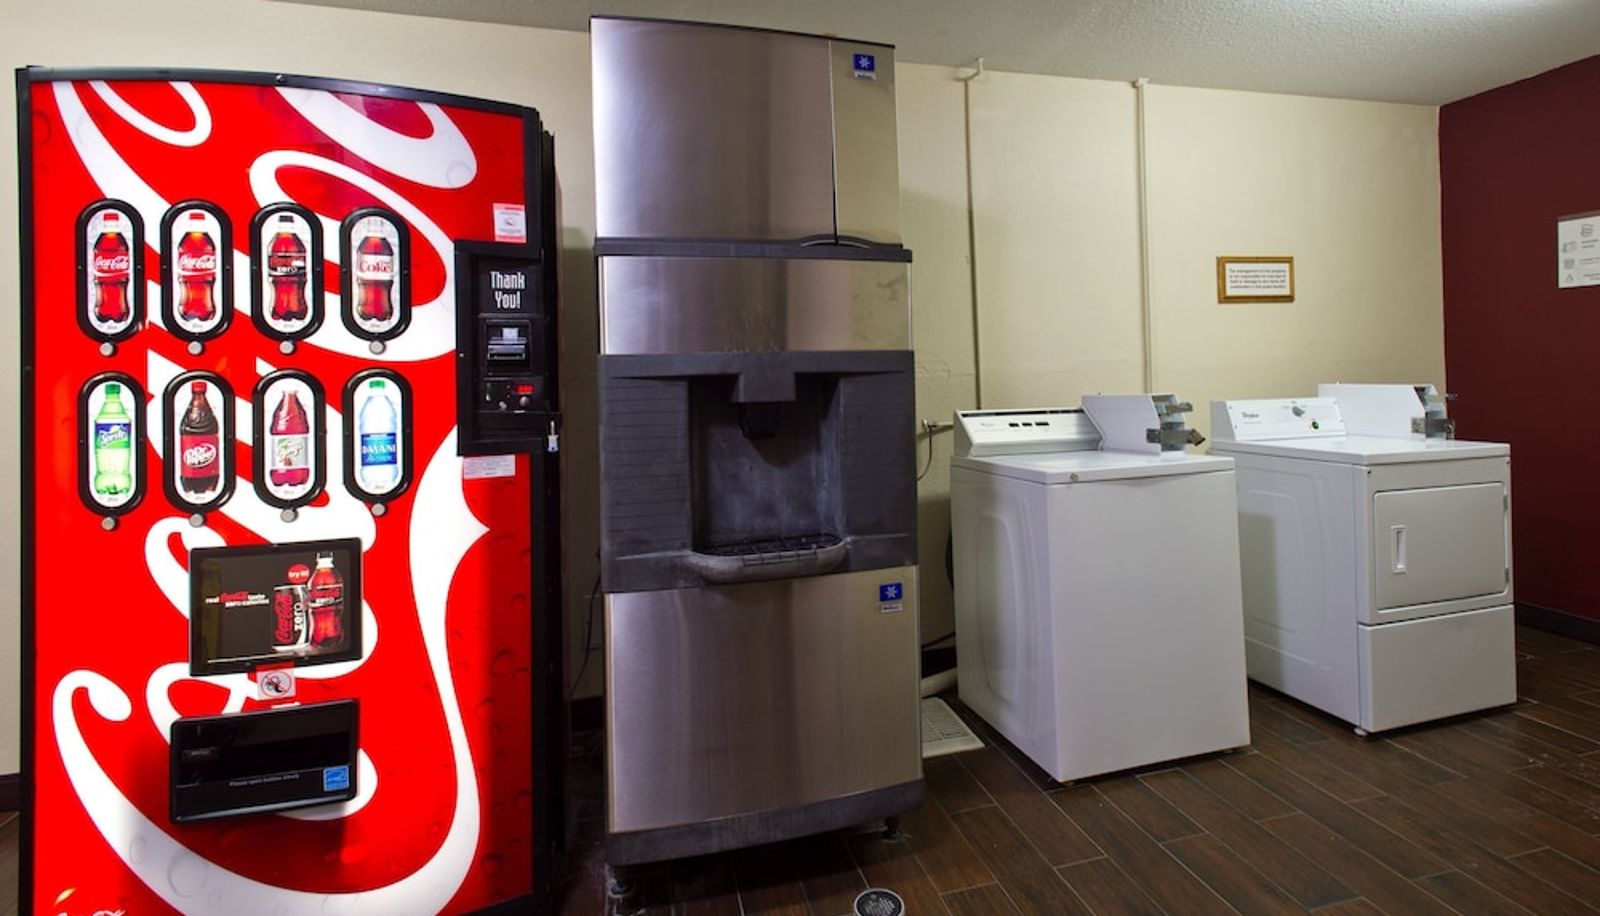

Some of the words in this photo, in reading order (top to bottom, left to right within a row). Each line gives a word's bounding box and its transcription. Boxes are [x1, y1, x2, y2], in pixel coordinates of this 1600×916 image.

[358, 260, 392, 273] Coke
[489, 271, 526, 289] Thank
[494, 291, 521, 309] You!
[99, 429, 127, 446] Sprite
